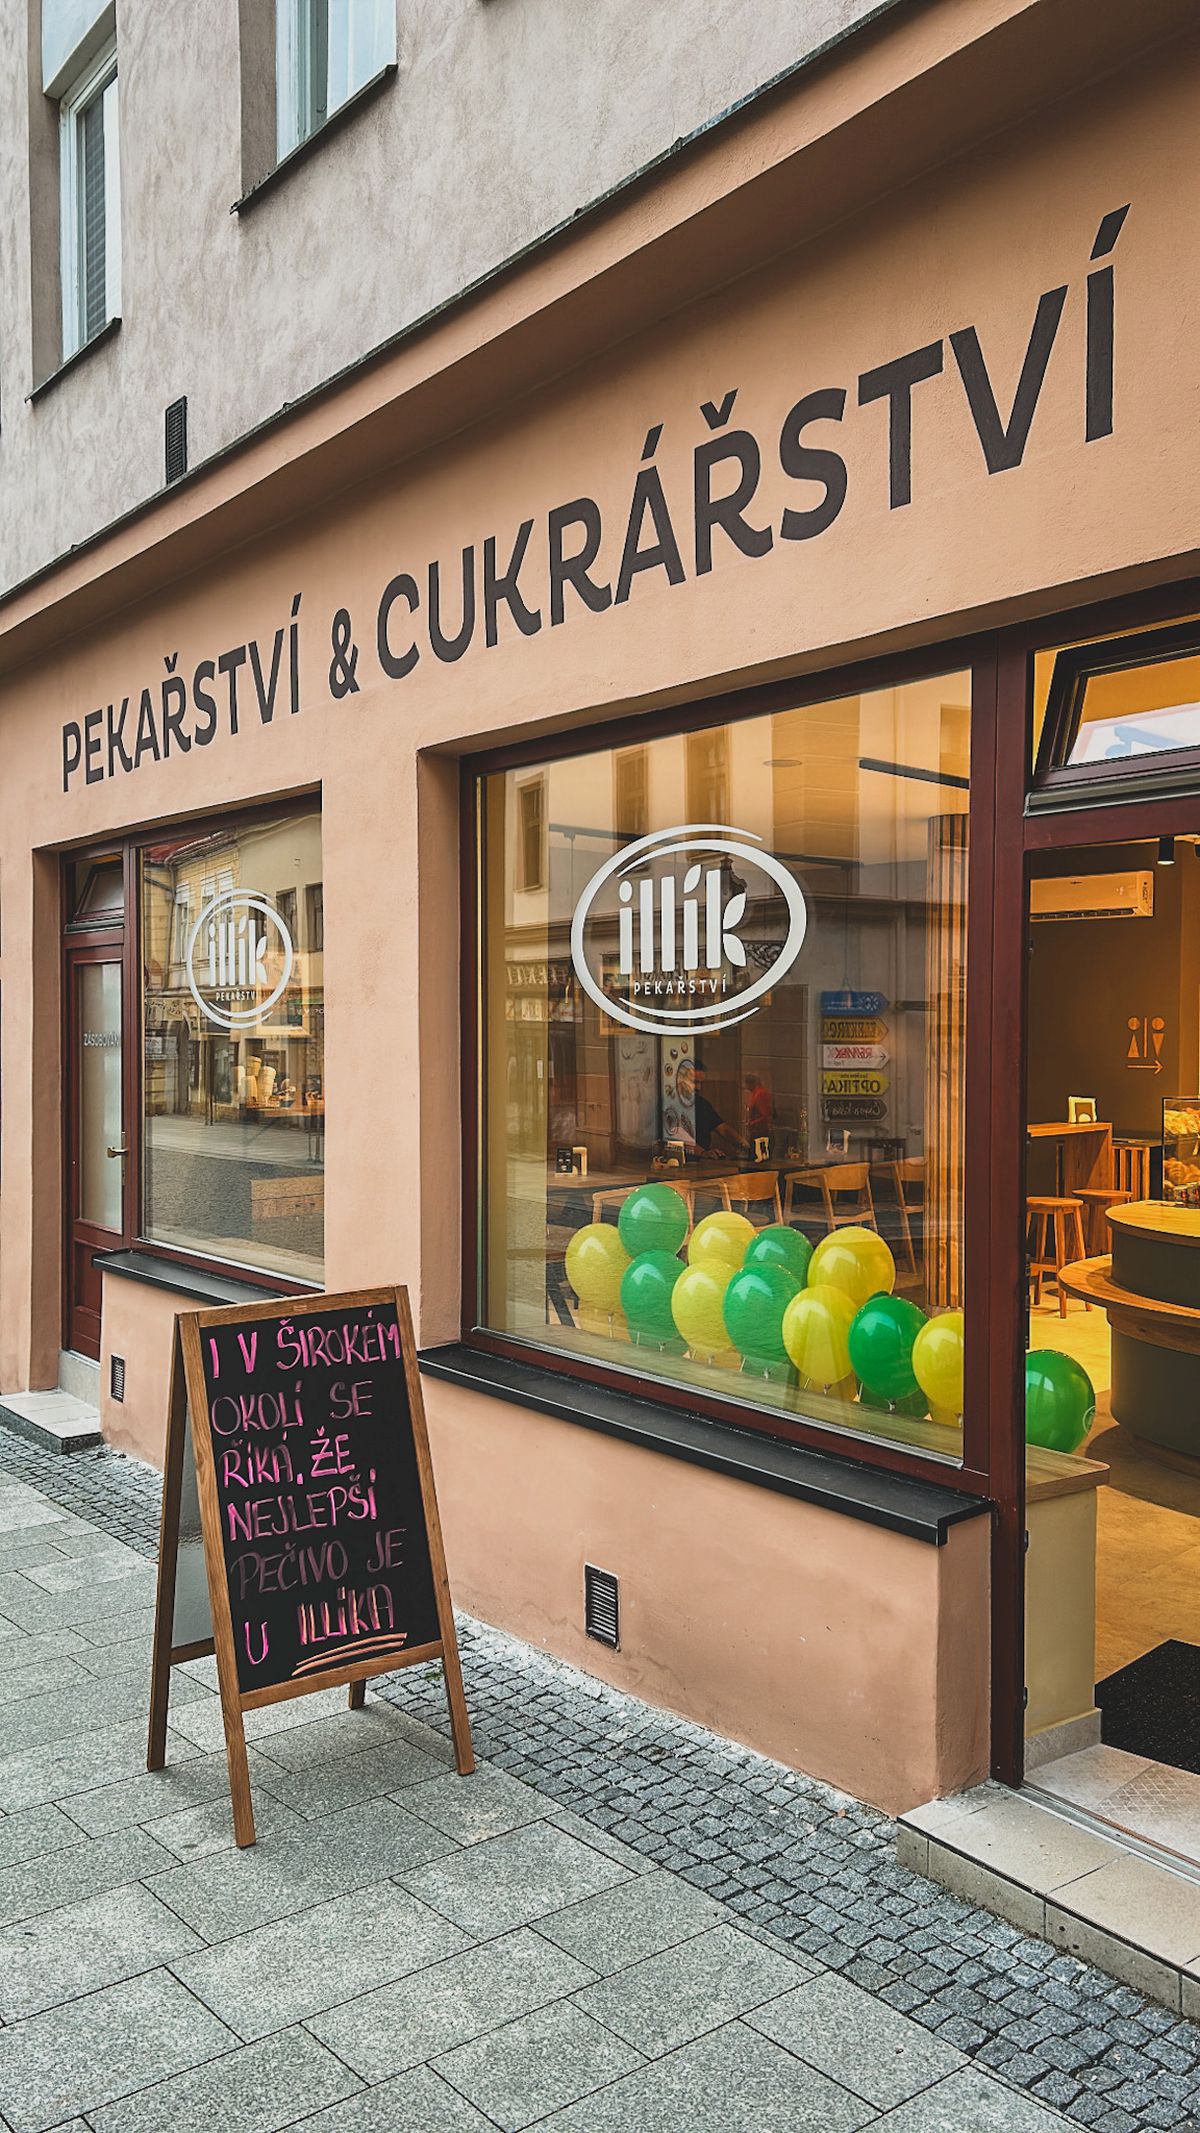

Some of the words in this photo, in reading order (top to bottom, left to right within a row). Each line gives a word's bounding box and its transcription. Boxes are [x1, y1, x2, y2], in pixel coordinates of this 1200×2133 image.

[62, 593, 302, 792] PEKAŘSTVÍ
[329, 608, 360, 699] &
[377, 203, 1131, 679] CUKRÁŘSTVÍ
[216, 990, 260, 1001] PEKAŘSTV
[633, 974, 726, 996] PEKAŘSTVÍ
[209, 1337, 219, 1379] I
[237, 1331, 258, 1374] V
[276, 1310, 401, 1370] ŠIROKÉM
[211, 1380, 304, 1436] OKOLÍ
[329, 1380, 373, 1420] SE
[310, 1425, 355, 1478] ŽE
[227, 1468, 377, 1541] NEJLEPŠÍ
[230, 1541, 349, 1600] PEČIVO
[366, 1528, 407, 1573] JE
[244, 1621, 269, 1665] U
[297, 1586, 394, 1646] ILLÍKA
